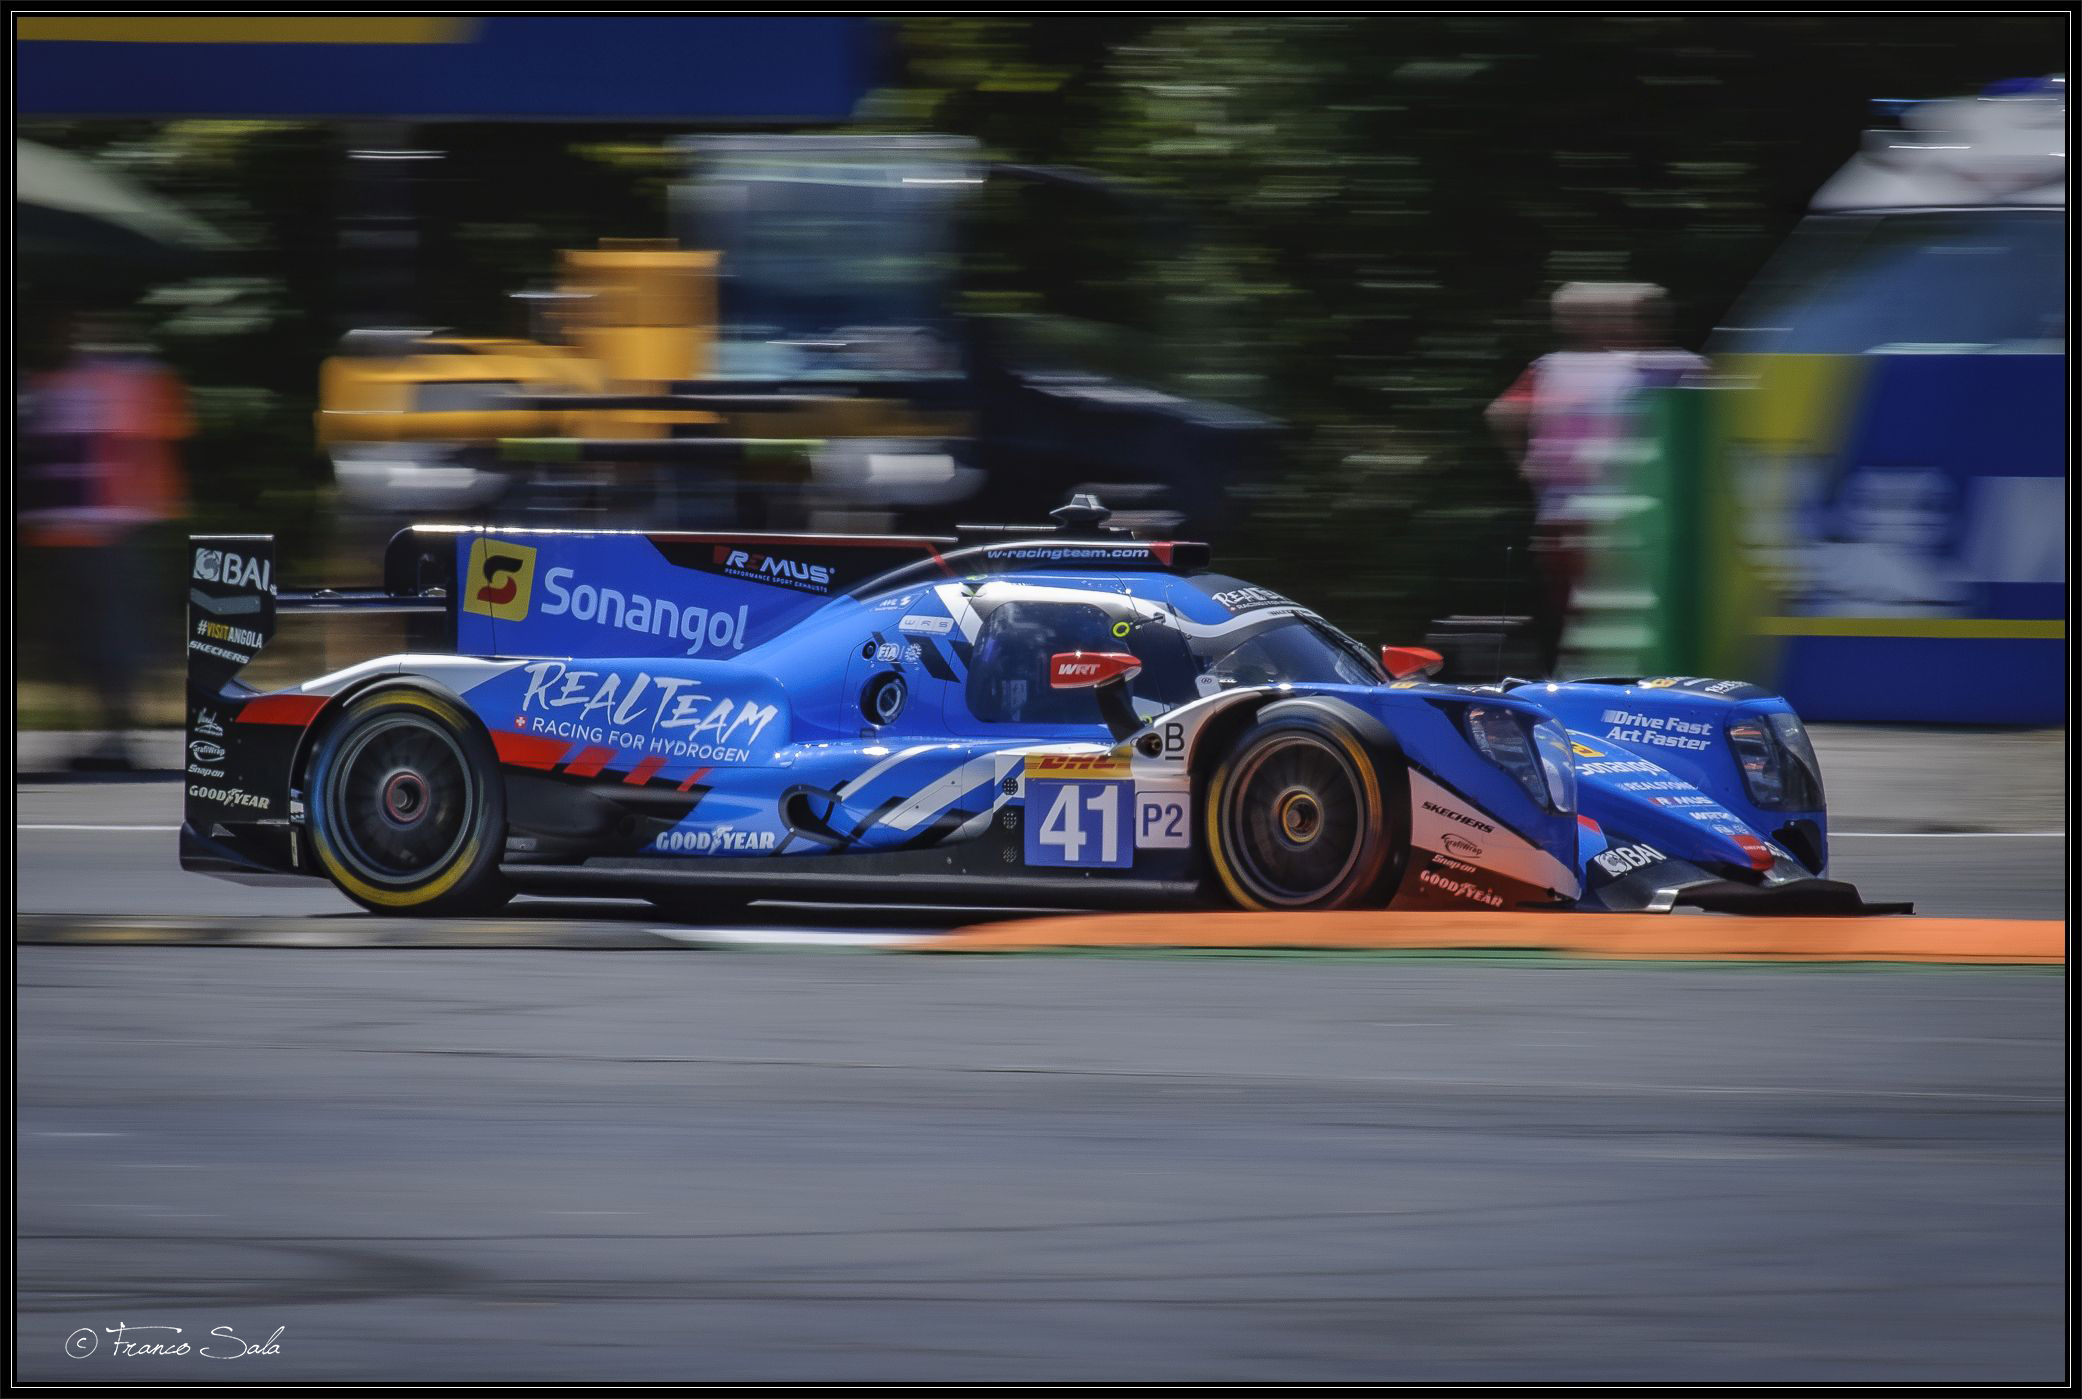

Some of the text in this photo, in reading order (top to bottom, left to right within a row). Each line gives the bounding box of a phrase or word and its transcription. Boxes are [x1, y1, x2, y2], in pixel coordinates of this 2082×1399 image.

[987, 548, 1149, 560] w-racingteam.com
[222, 552, 270, 592] BAI
[724, 568, 770, 581] PERFORMANCE
[541, 566, 749, 655] Sonangol
[197, 620, 263, 649] #VISITANGOLA
[189, 640, 250, 664] SKECHERS
[879, 645, 898, 659] FIA
[1058, 663, 1100, 675] WRT
[1165, 723, 1185, 752] B
[1613, 711, 1713, 736] Drive Fast
[532, 718, 750, 763] RACING FOR HYDROGEN
[1606, 727, 1711, 751] Act Faster
[1039, 755, 1116, 770] DHL
[189, 785, 270, 809] GOODYEAR
[1040, 785, 1118, 862] 41
[1142, 804, 1183, 838] P2
[1422, 801, 1496, 834] SKECHERS
[656, 825, 776, 854] GOODYEAR
[1618, 843, 1668, 870] BAI
[1420, 869, 1504, 908] GOODYEAR
